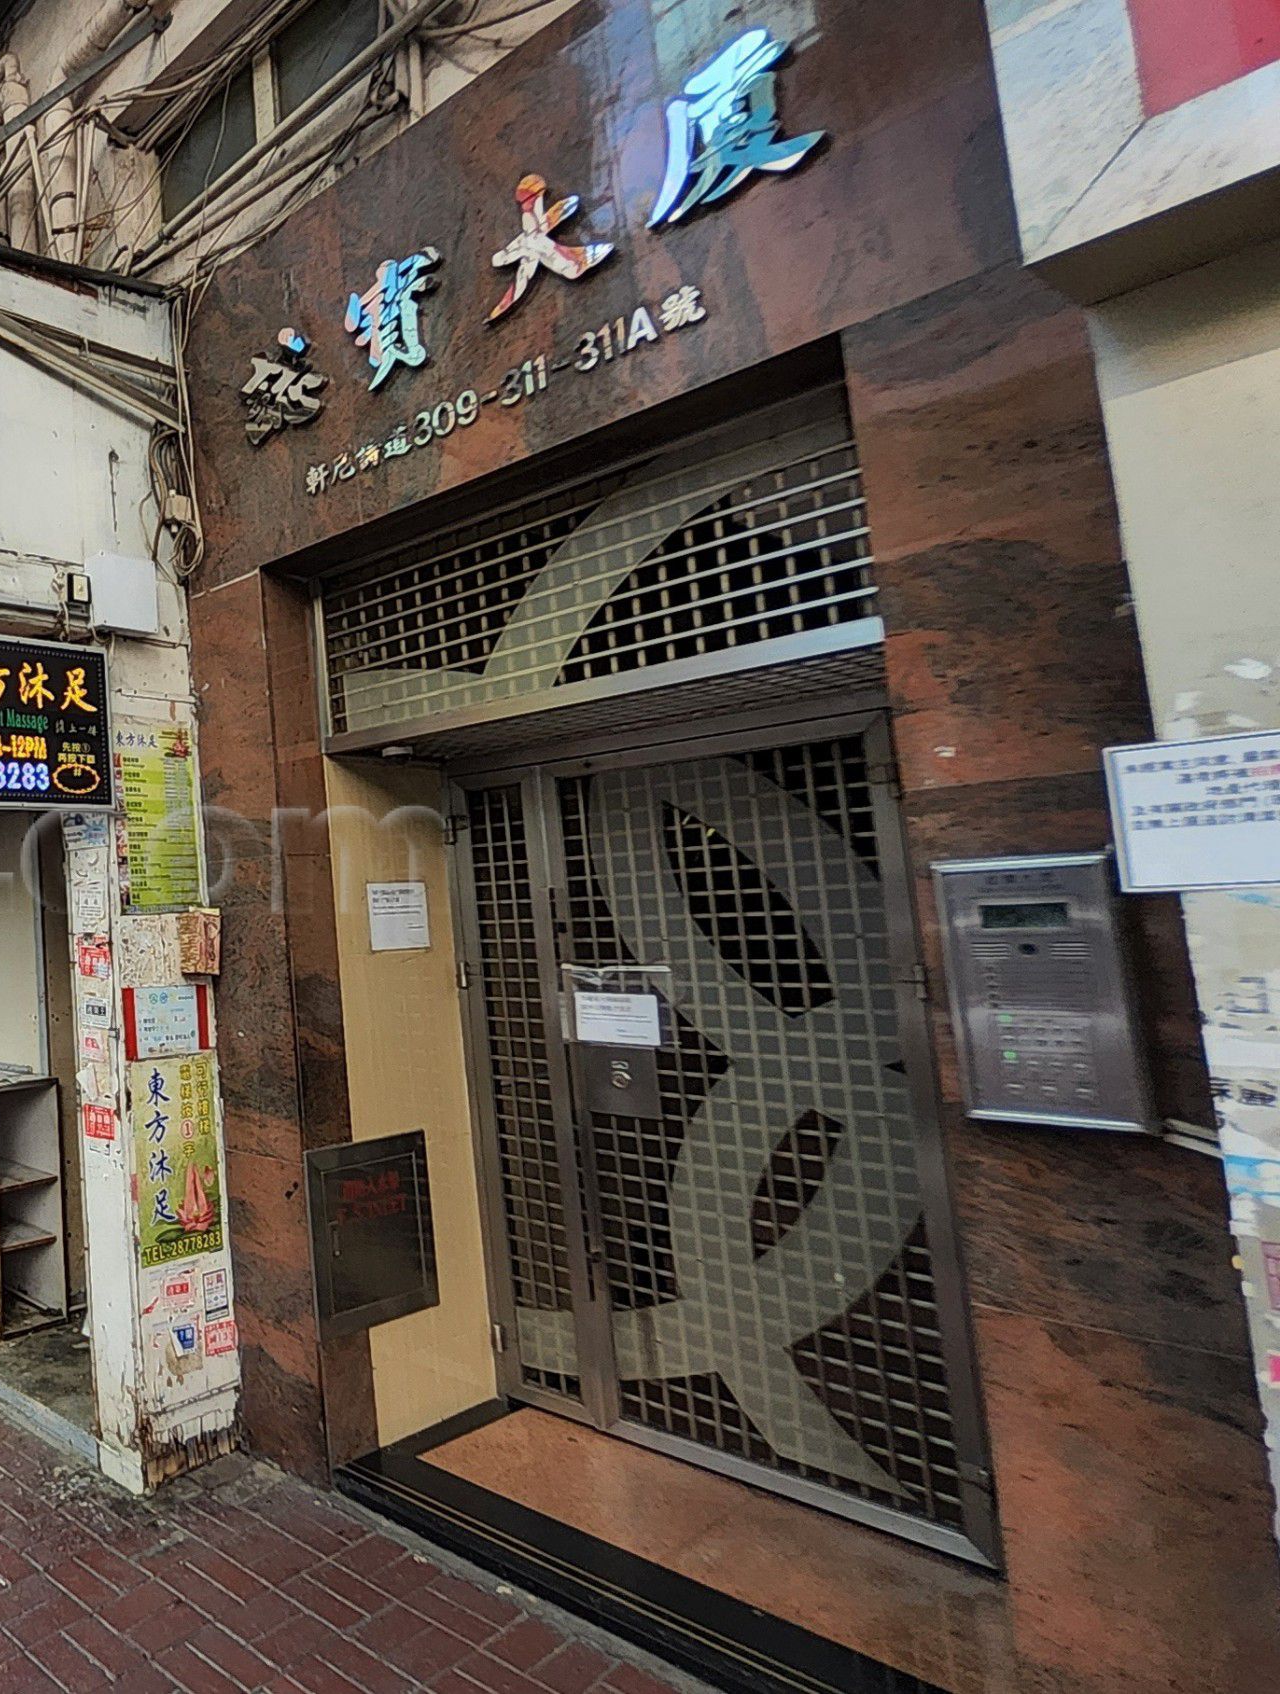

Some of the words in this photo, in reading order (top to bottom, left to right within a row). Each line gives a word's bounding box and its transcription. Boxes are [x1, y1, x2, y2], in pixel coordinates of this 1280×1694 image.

[6, 709, 49, 733] Massage
[144, 1066, 177, 1227] 東方沐足
